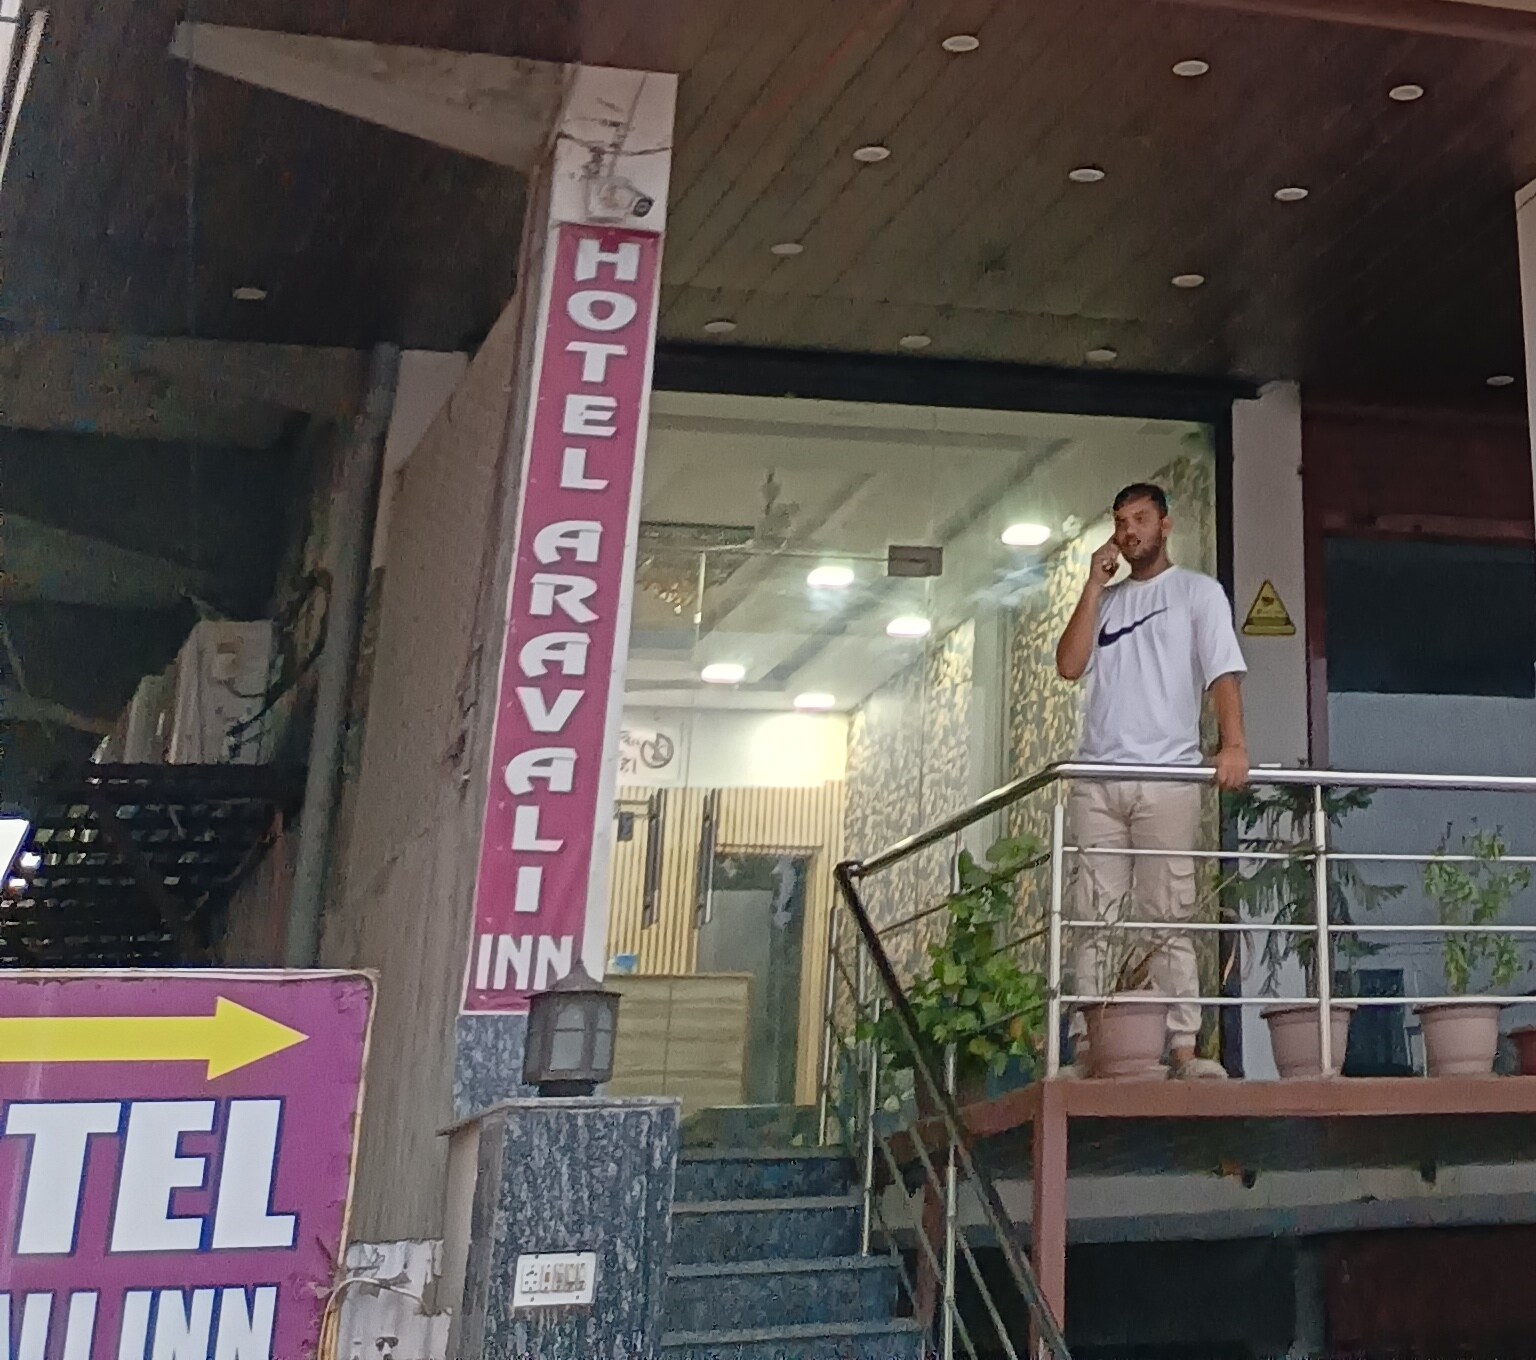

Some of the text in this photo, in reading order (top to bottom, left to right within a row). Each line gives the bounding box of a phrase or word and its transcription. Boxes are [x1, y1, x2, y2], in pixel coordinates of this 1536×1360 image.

[560, 239, 641, 491] HOTEL
[504, 520, 603, 913] ARAVALI
[475, 933, 573, 992] INN
[3, 1100, 297, 1255] TEL
[117, 1285, 279, 1360] INN
